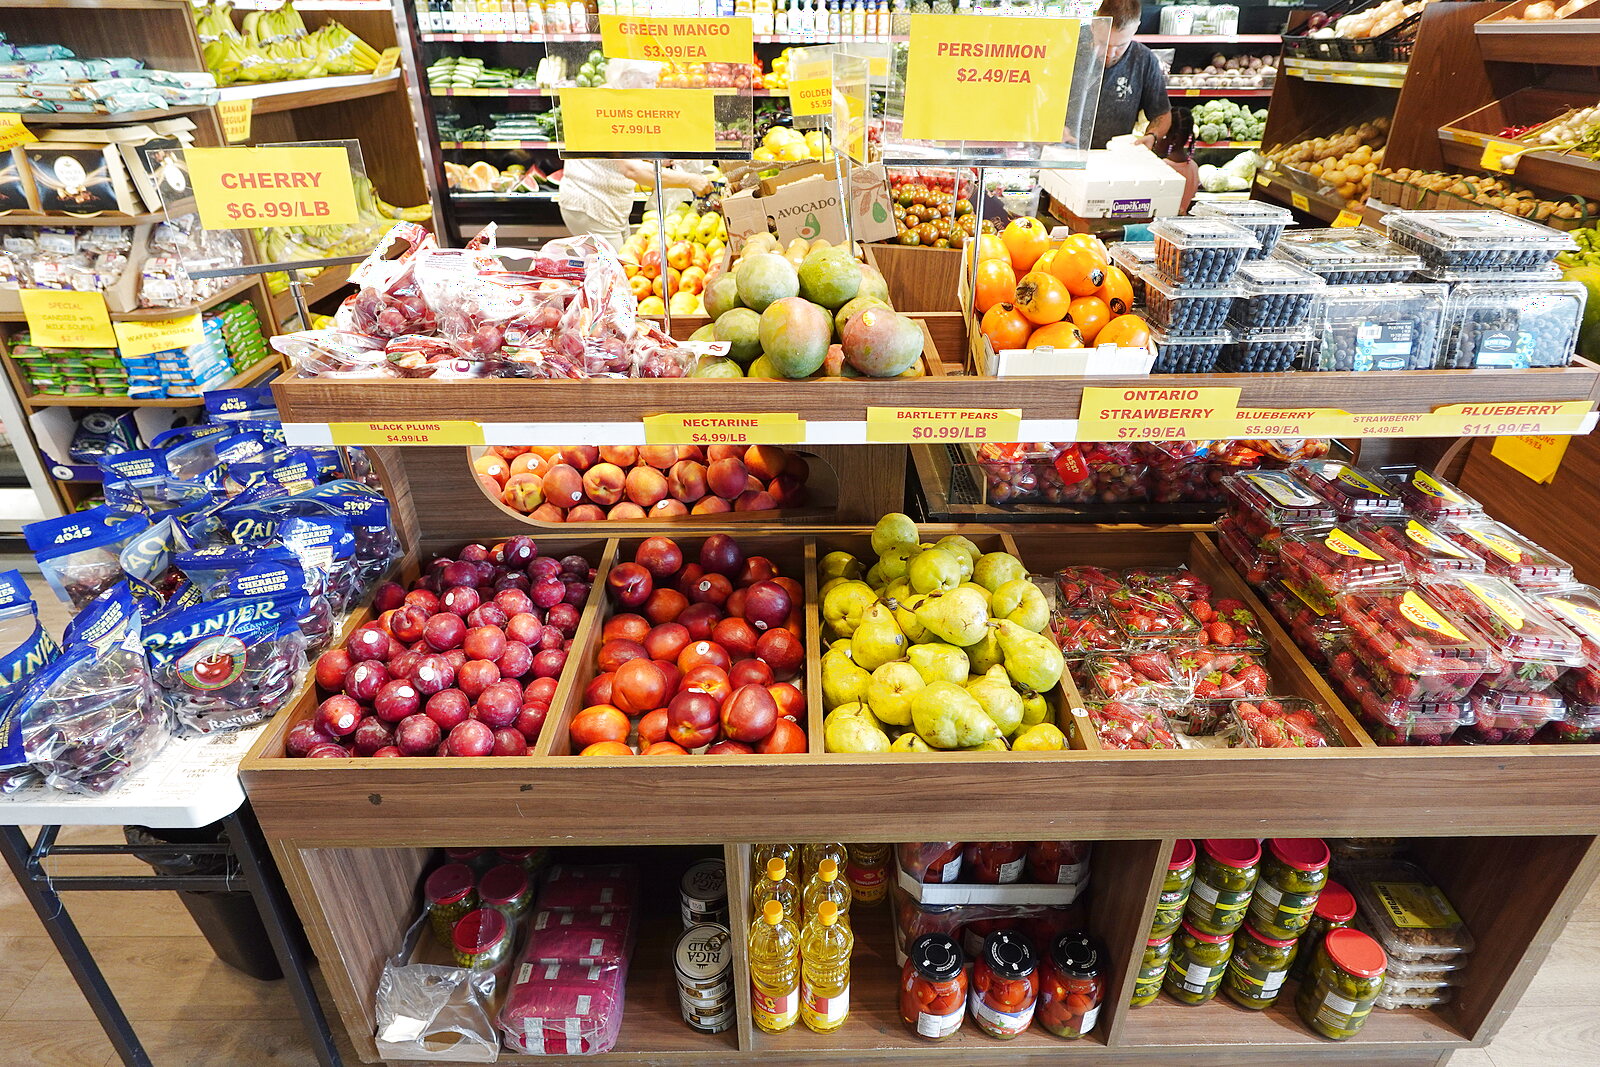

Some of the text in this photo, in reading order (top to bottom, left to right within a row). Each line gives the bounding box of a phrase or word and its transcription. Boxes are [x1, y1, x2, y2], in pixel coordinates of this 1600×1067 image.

[618, 22, 730, 36] GREEN MANGO
[644, 45, 707, 58] $3.99/EA
[937, 42, 1046, 58] PERSIMMON
[956, 68, 1031, 84] $2.49/EA
[800, 88, 832, 98] GOLDEN
[596, 109, 680, 118] PLUMS CHERRY
[611, 124, 661, 134] $7.99/LB
[220, 172, 322, 189] CHERRY
[226, 201, 330, 221] $6.99/LB
[778, 197, 836, 219] AVOCADO
[1124, 390, 1198, 400] ONTARIO
[220, 401, 248, 411] 4045
[1461, 405, 1563, 416] BLUEBERRY
[960, 412, 998, 420] PEARS
[1100, 408, 1214, 420] STRAWBERRY
[1236, 412, 1316, 420] BLUEBERRY
[682, 419, 758, 427] NECTARINE
[1462, 423, 1540, 434] $11.99/EA
[912, 426, 986, 439] $0.99/LB
[1118, 427, 1186, 438] $7.99/EA
[1245, 426, 1300, 434] $5.99/EA
[1362, 426, 1404, 434] $4.49/EA
[692, 434, 746, 442] $4.99/LB
[344, 502, 372, 510] 4045
[62, 524, 79, 534] PLU
[54, 526, 92, 544] 4045
[194, 548, 227, 556] 4045
[238, 574, 288, 590] CHERRIES
[244, 582, 286, 596] CERISES
[141, 601, 280, 664] RAINIER
[687, 952, 721, 964] RIGA
